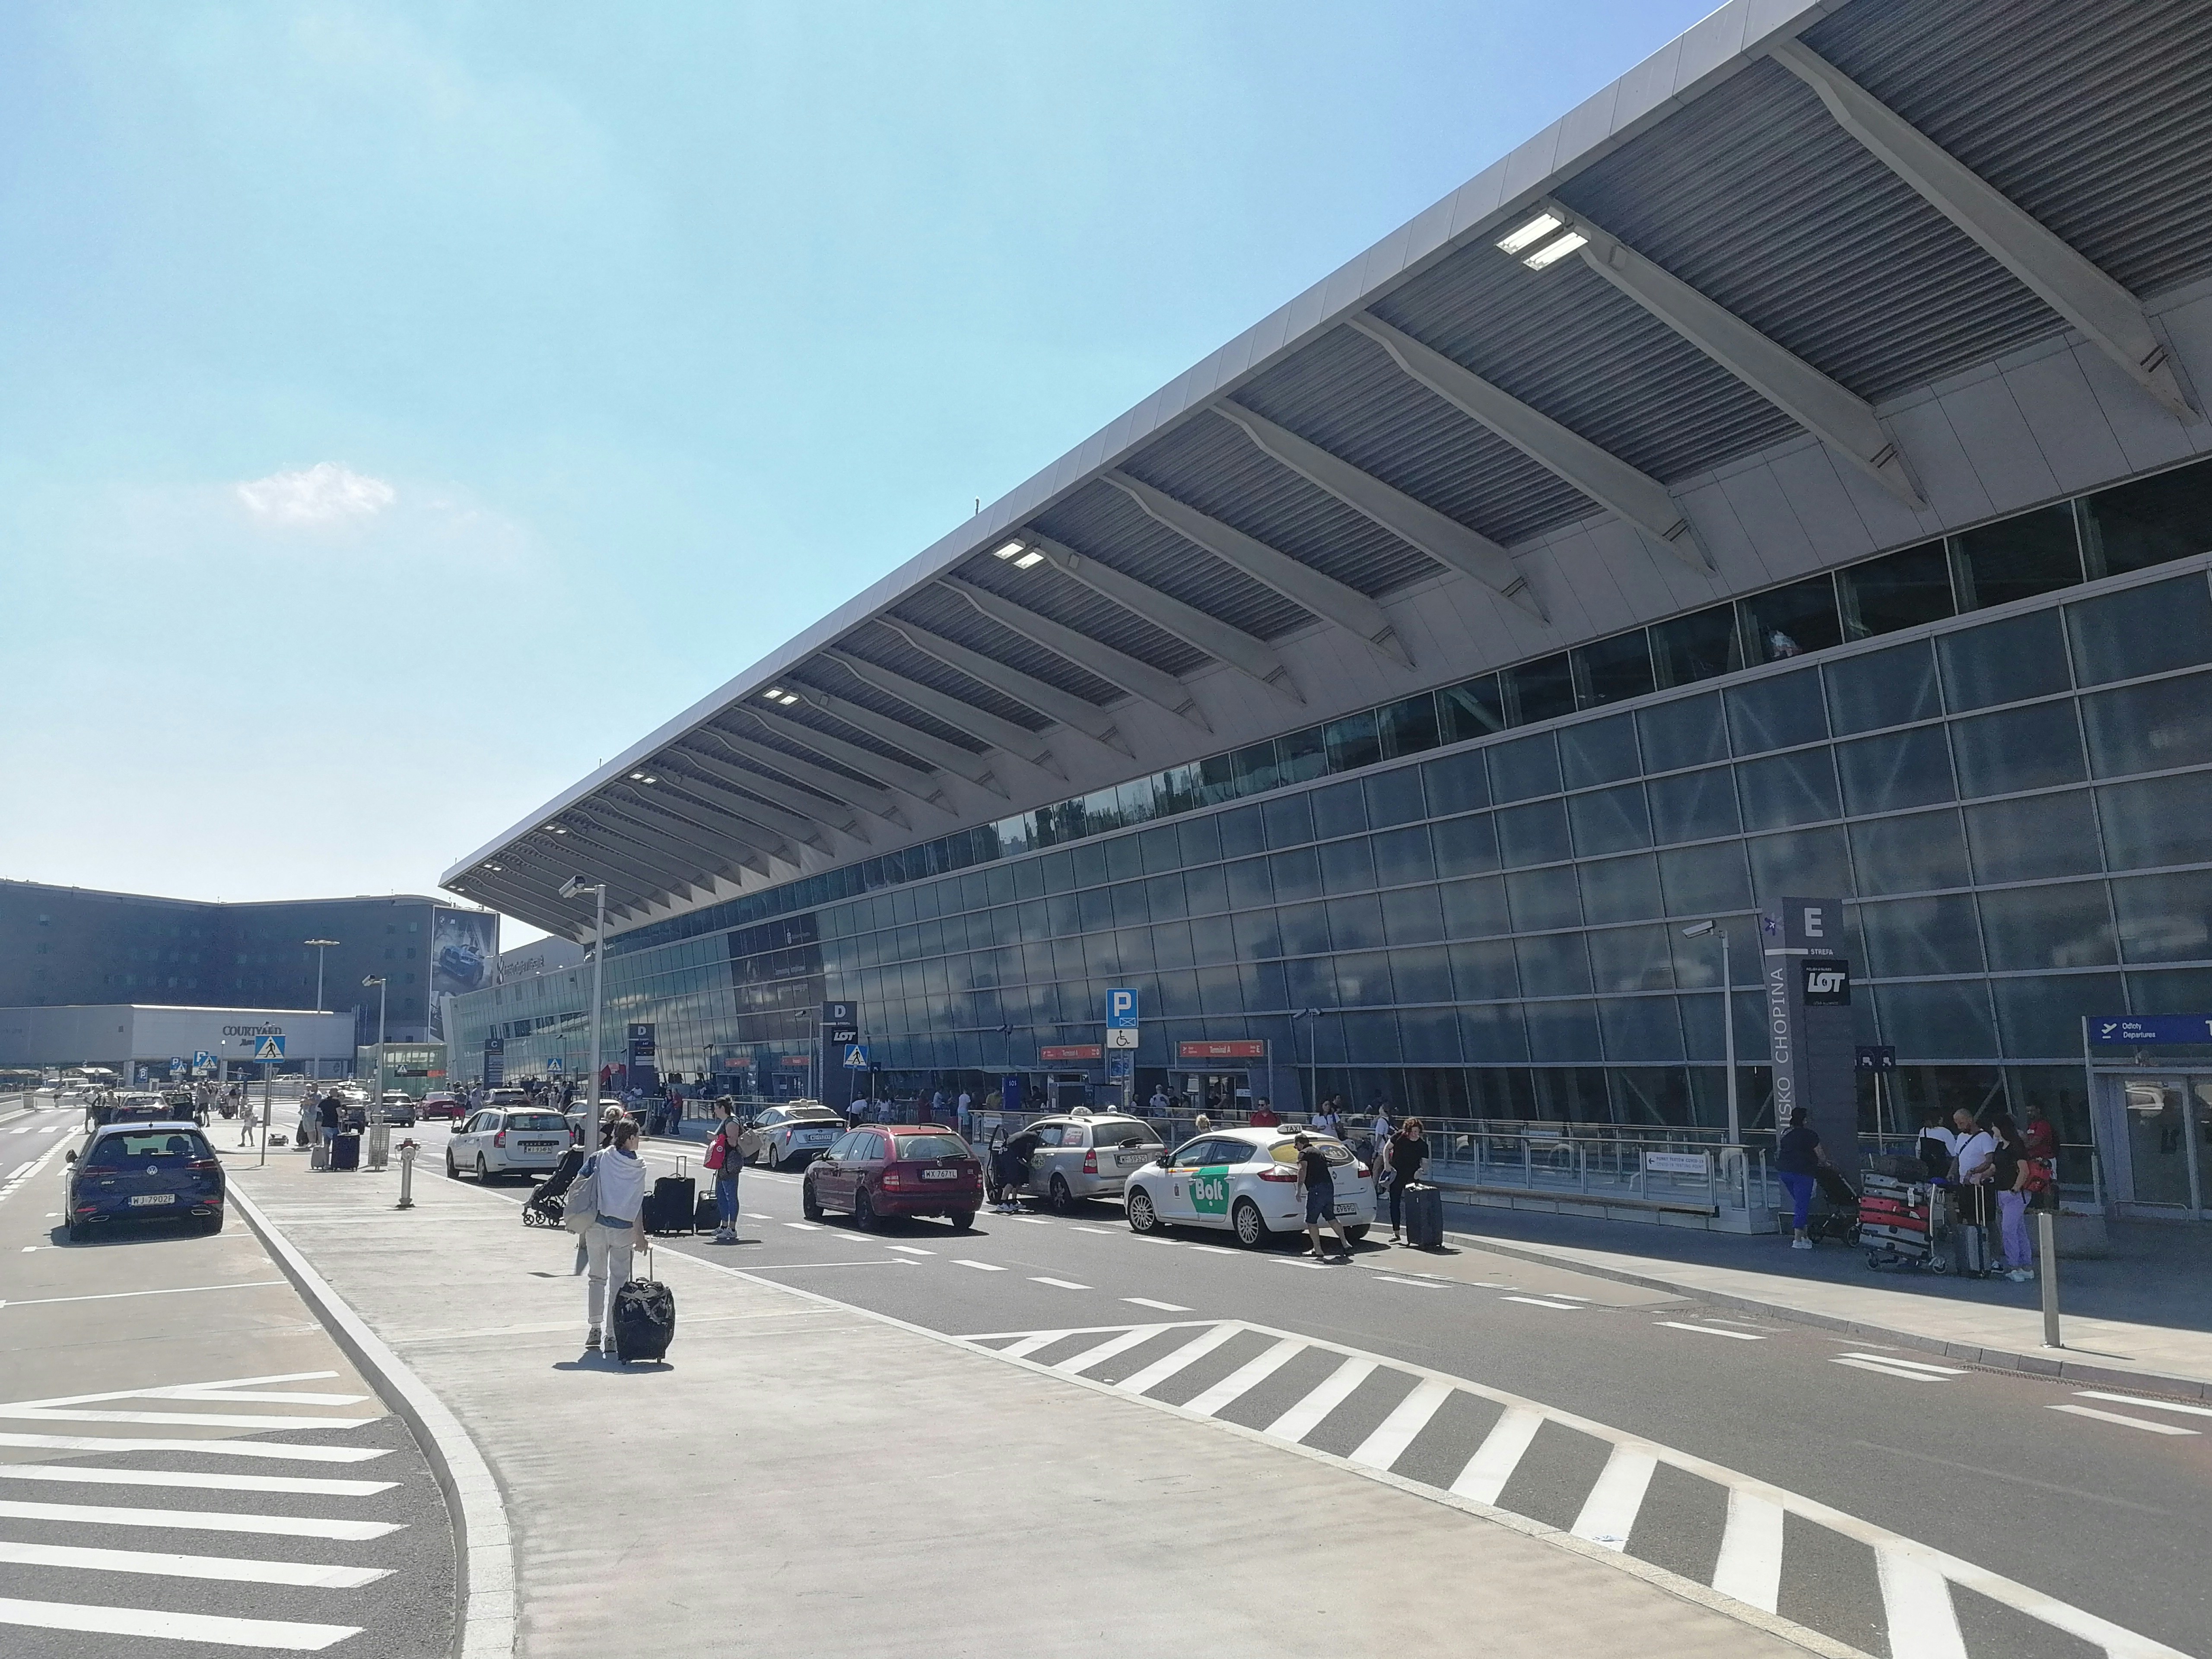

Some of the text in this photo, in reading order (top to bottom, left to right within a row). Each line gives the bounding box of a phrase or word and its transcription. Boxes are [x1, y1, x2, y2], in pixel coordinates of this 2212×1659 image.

[1804, 907, 1823, 937] E
[1808, 973, 1846, 992] LOT
[1114, 992, 1131, 1017] P
[834, 1005, 846, 1018] D
[1770, 968, 1789, 1064] CHOPINA
[637, 1026, 647, 1036] D
[2122, 1022, 2142, 1030] Odloty
[833, 1032, 856, 1041] LOT
[2123, 1031, 2156, 1039] Departures
[1256, 1045, 1261, 1053] E
[1195, 1178, 1224, 1200] Bolt
[148, 1194, 174, 1203] 7902F
